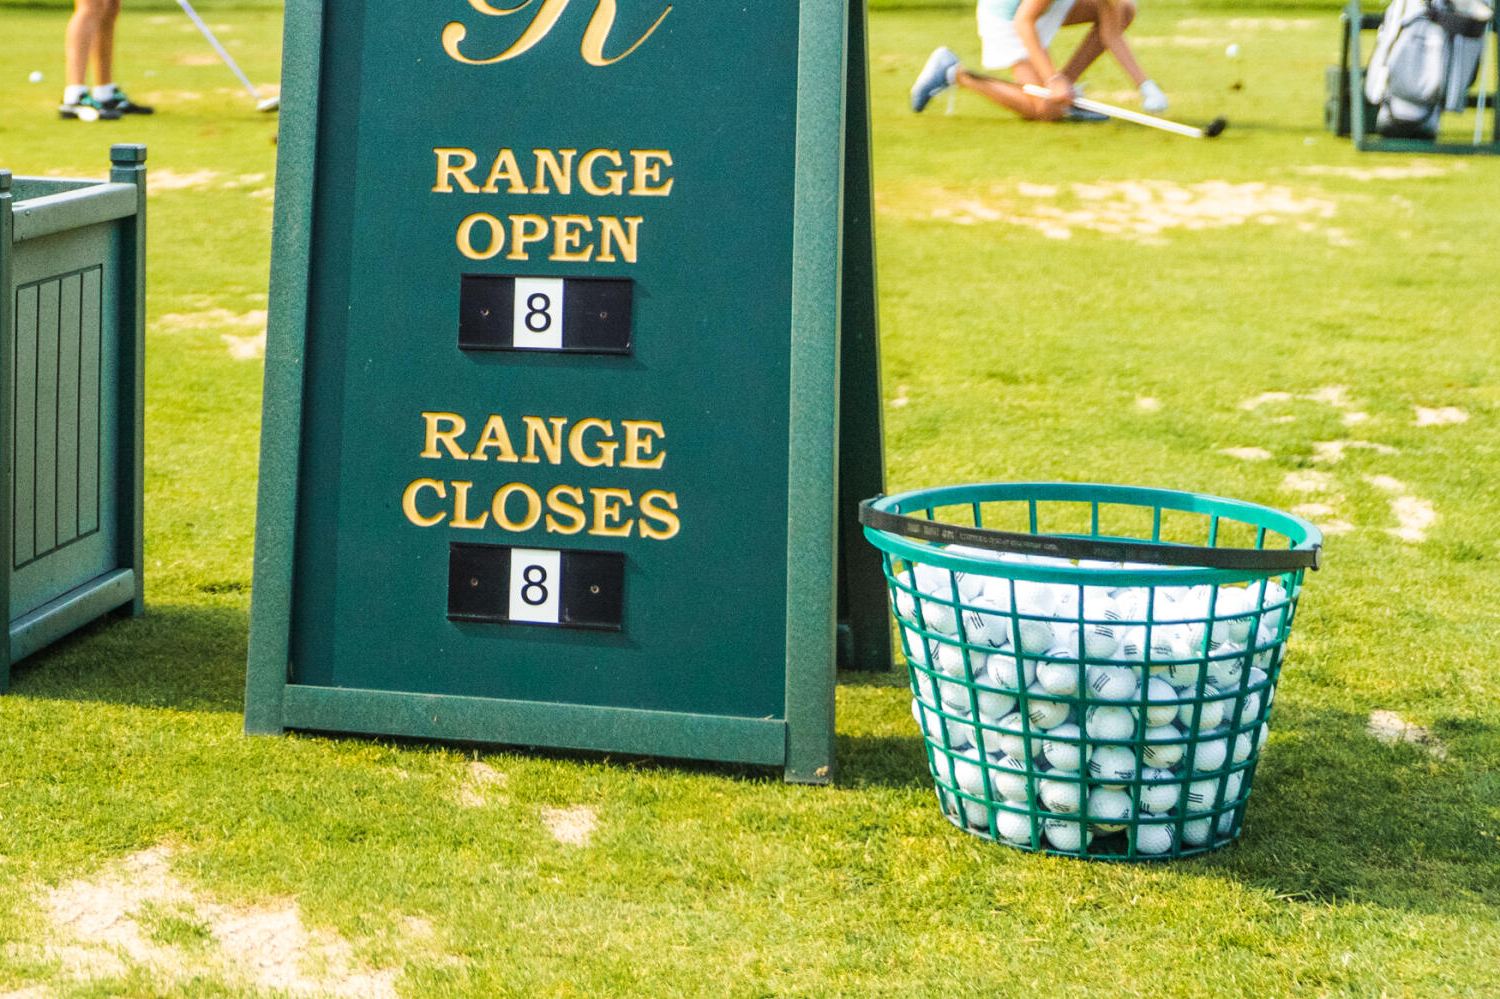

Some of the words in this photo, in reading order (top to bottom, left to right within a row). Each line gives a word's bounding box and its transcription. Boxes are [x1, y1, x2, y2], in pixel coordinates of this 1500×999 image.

[431, 147, 674, 197] RANGE
[455, 212, 643, 263] OPEN
[524, 292, 552, 333] 8
[419, 411, 667, 470] RANGE
[402, 477, 681, 541] CLOSES
[520, 564, 548, 606] 8
